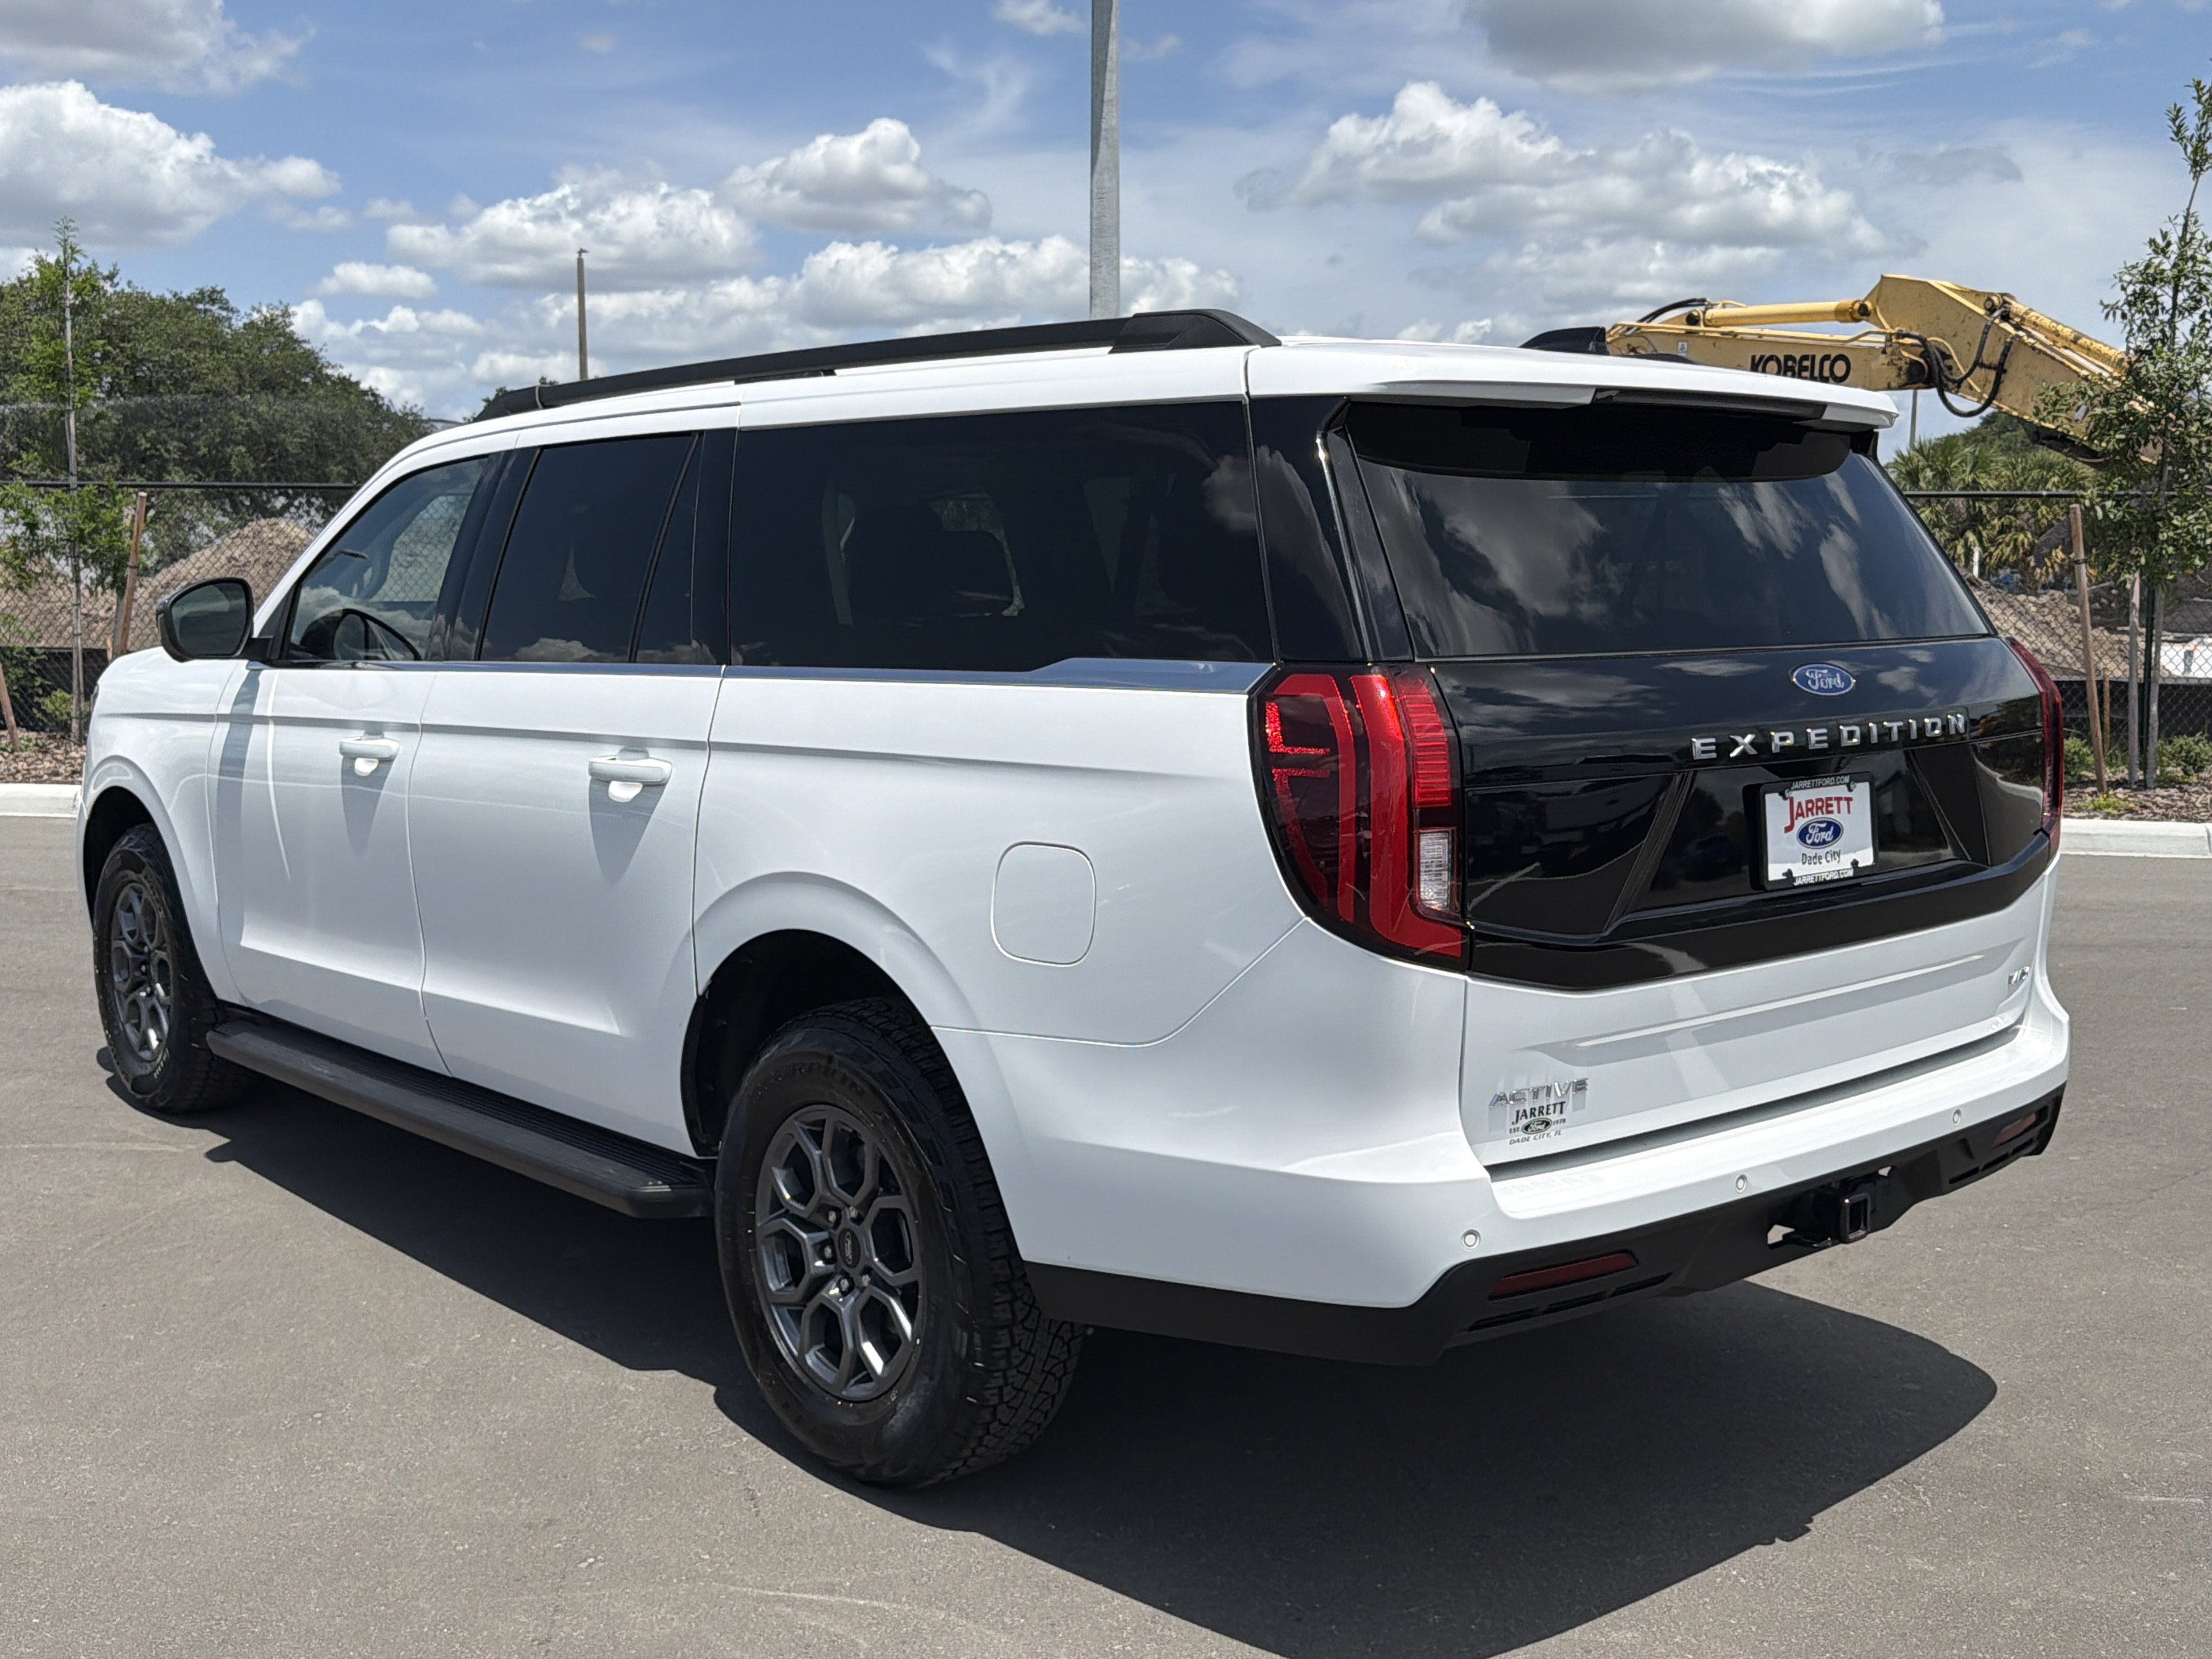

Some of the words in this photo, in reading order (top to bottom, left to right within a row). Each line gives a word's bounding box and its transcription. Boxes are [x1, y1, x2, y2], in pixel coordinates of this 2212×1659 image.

[1750, 354, 1851, 383] KOBELCO
[1805, 669, 1844, 690] Ford
[1691, 713, 1966, 760] EXPEDITION
[1791, 775, 1850, 790] JARRETTFORD.COM
[1784, 796, 1853, 833] JARRETT
[1805, 822, 1834, 844] Ford
[1802, 853, 1822, 865] Dade
[1825, 849, 1841, 863] City
[1793, 869, 1853, 886] JARRETTFORD.COM
[1488, 1077, 1589, 1107] ACTIVE
[1511, 1101, 1566, 1125] JARRETT
[1509, 1136, 1531, 1146] DADE
